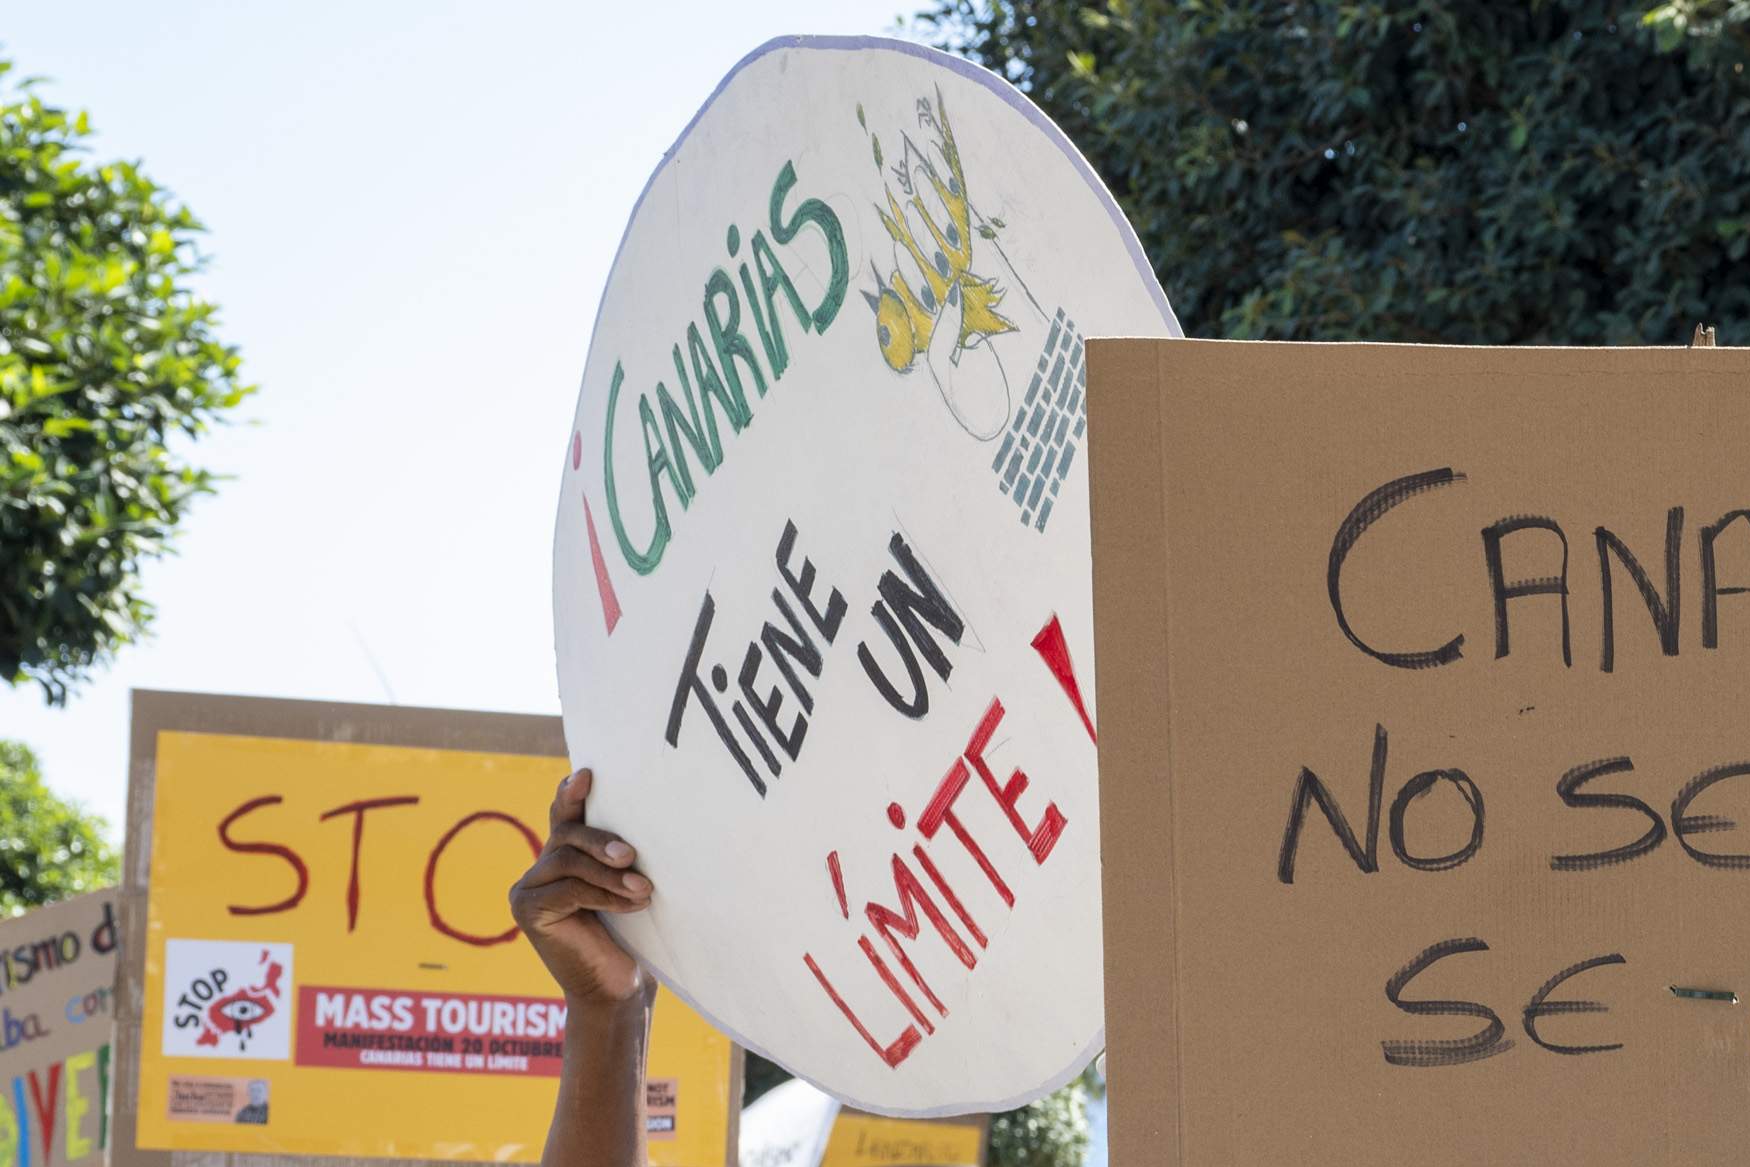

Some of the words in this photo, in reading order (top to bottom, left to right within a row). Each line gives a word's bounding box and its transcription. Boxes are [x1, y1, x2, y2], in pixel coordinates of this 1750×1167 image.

[857, 529, 965, 719] UN
[1277, 722, 1486, 885] NO
[217, 795, 544, 948] STO
[174, 968, 229, 1030] STOP
[314, 992, 414, 1031] MASS
[323, 1030, 454, 1054] MANIFESTACIÓN
[460, 1036, 483, 1055] 20
[489, 1037, 564, 1058] OCTUBRE
[1380, 937, 1627, 1067] SE
